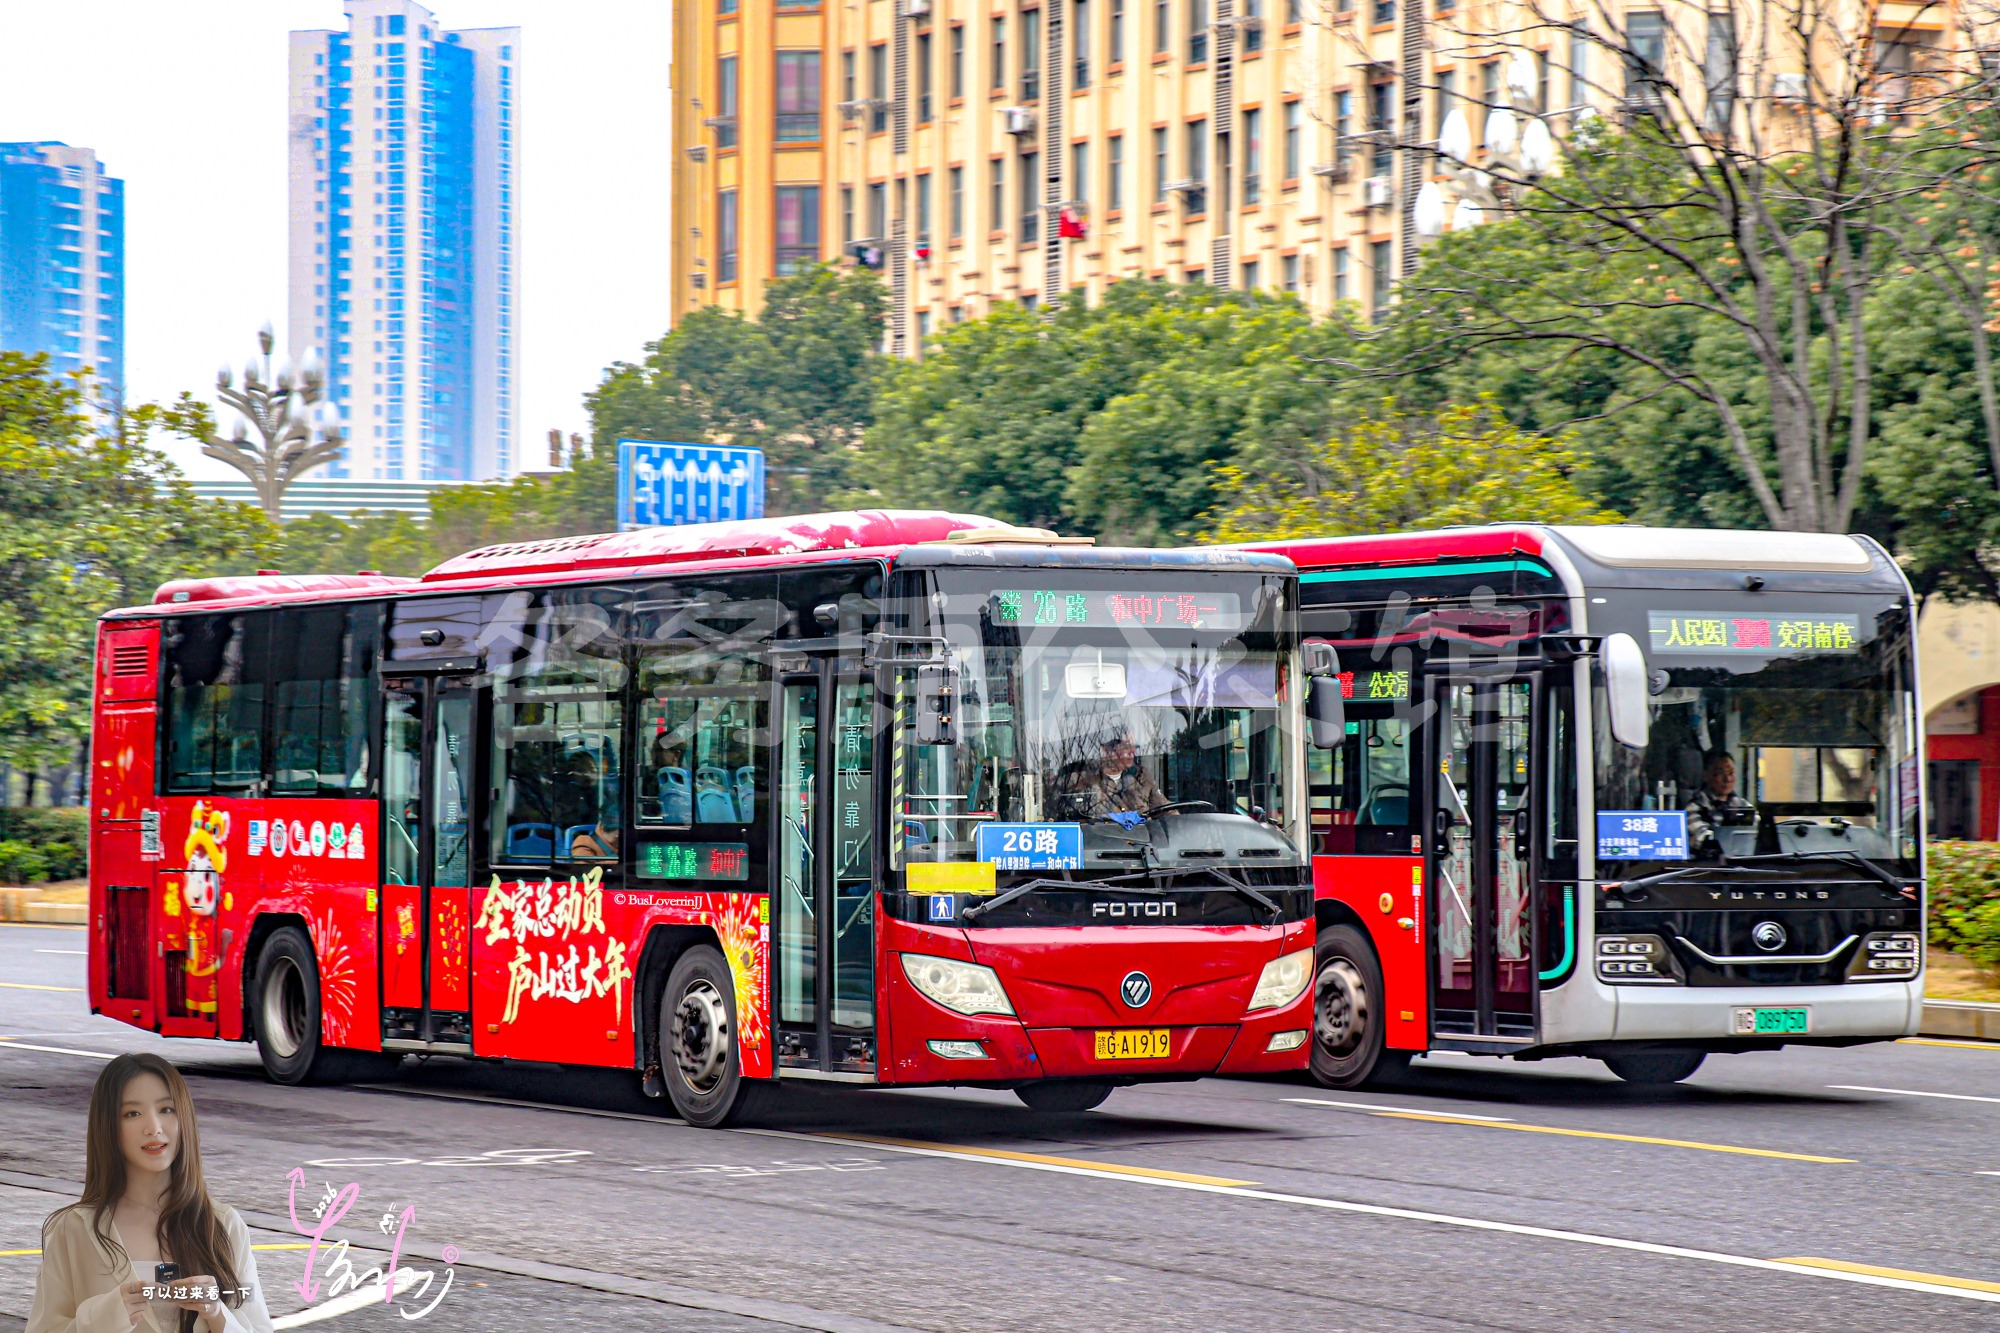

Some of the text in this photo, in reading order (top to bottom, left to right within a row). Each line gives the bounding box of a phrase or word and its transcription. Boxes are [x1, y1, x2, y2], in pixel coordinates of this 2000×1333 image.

[1622, 816, 1659, 833] 38路
[1003, 828, 1058, 855] 26路
[473, 865, 606, 947] 全家总动员
[1709, 891, 1829, 899] YUTONG
[1092, 902, 1177, 917] FOTON
[500, 936, 632, 1030] 庐山过大年
